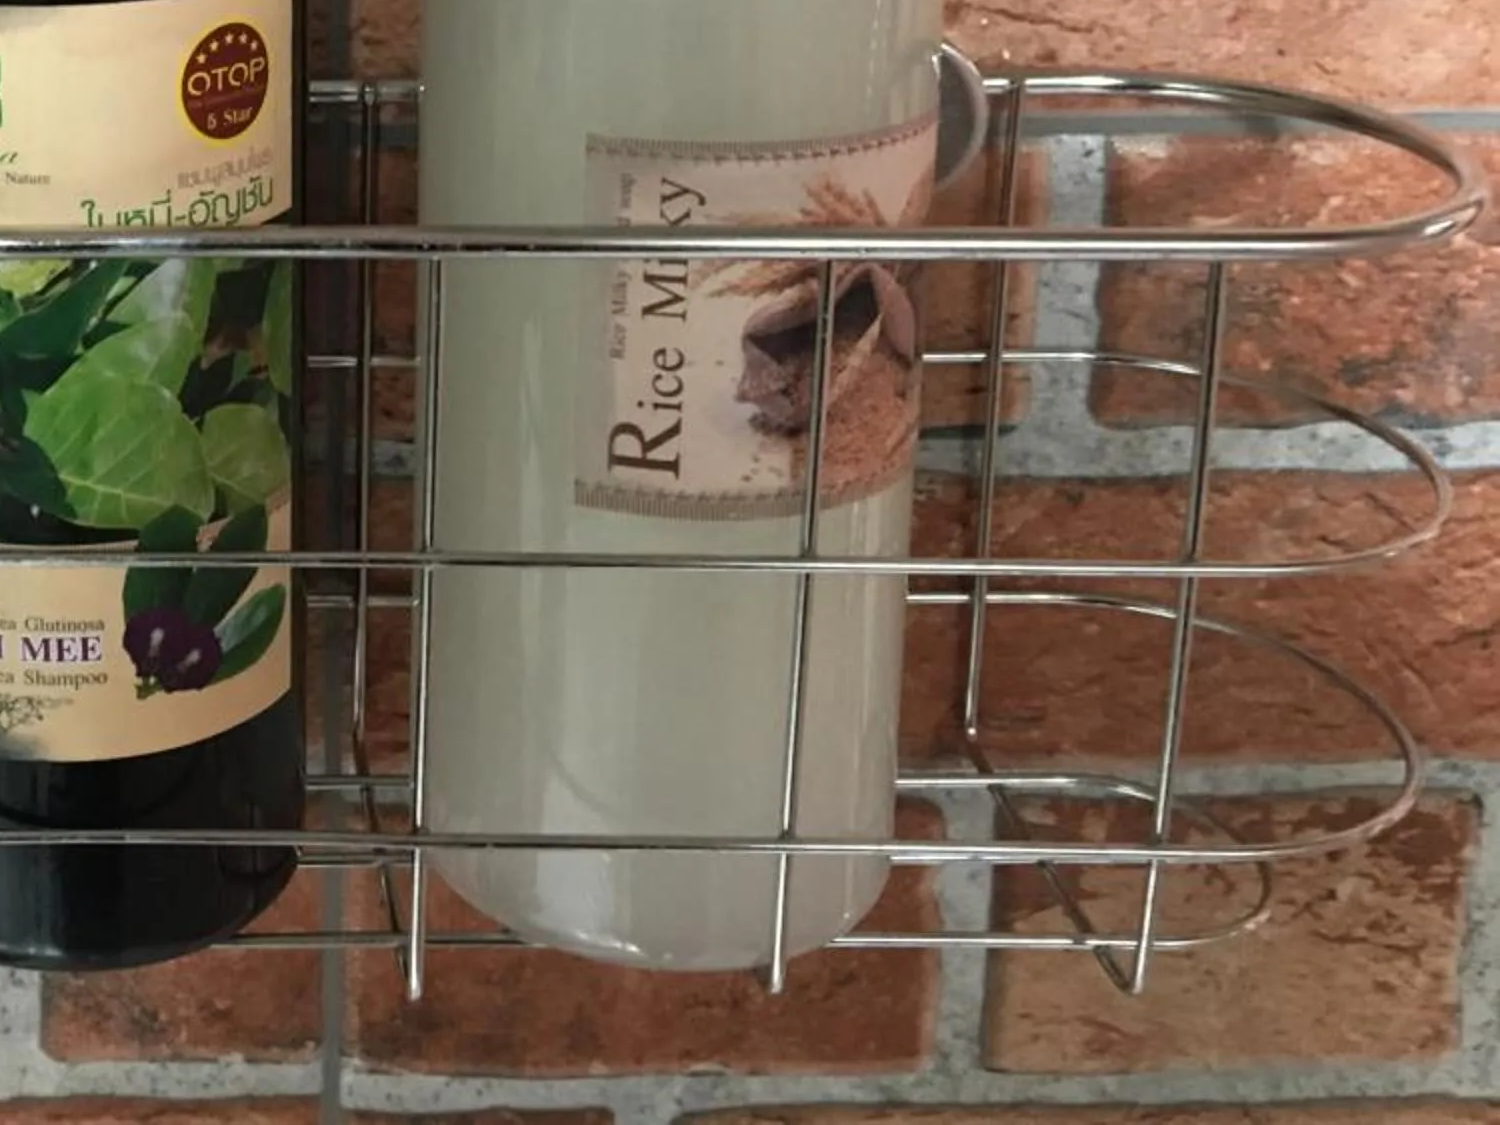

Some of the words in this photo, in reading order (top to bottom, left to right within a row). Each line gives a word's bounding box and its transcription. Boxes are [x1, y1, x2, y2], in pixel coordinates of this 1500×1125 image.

[187, 57, 266, 96] OTOP
[607, 346, 685, 480] Rice
[24, 614, 106, 632] Glutinosa
[21, 634, 103, 663] MEE
[23, 669, 108, 691] Shampoo
